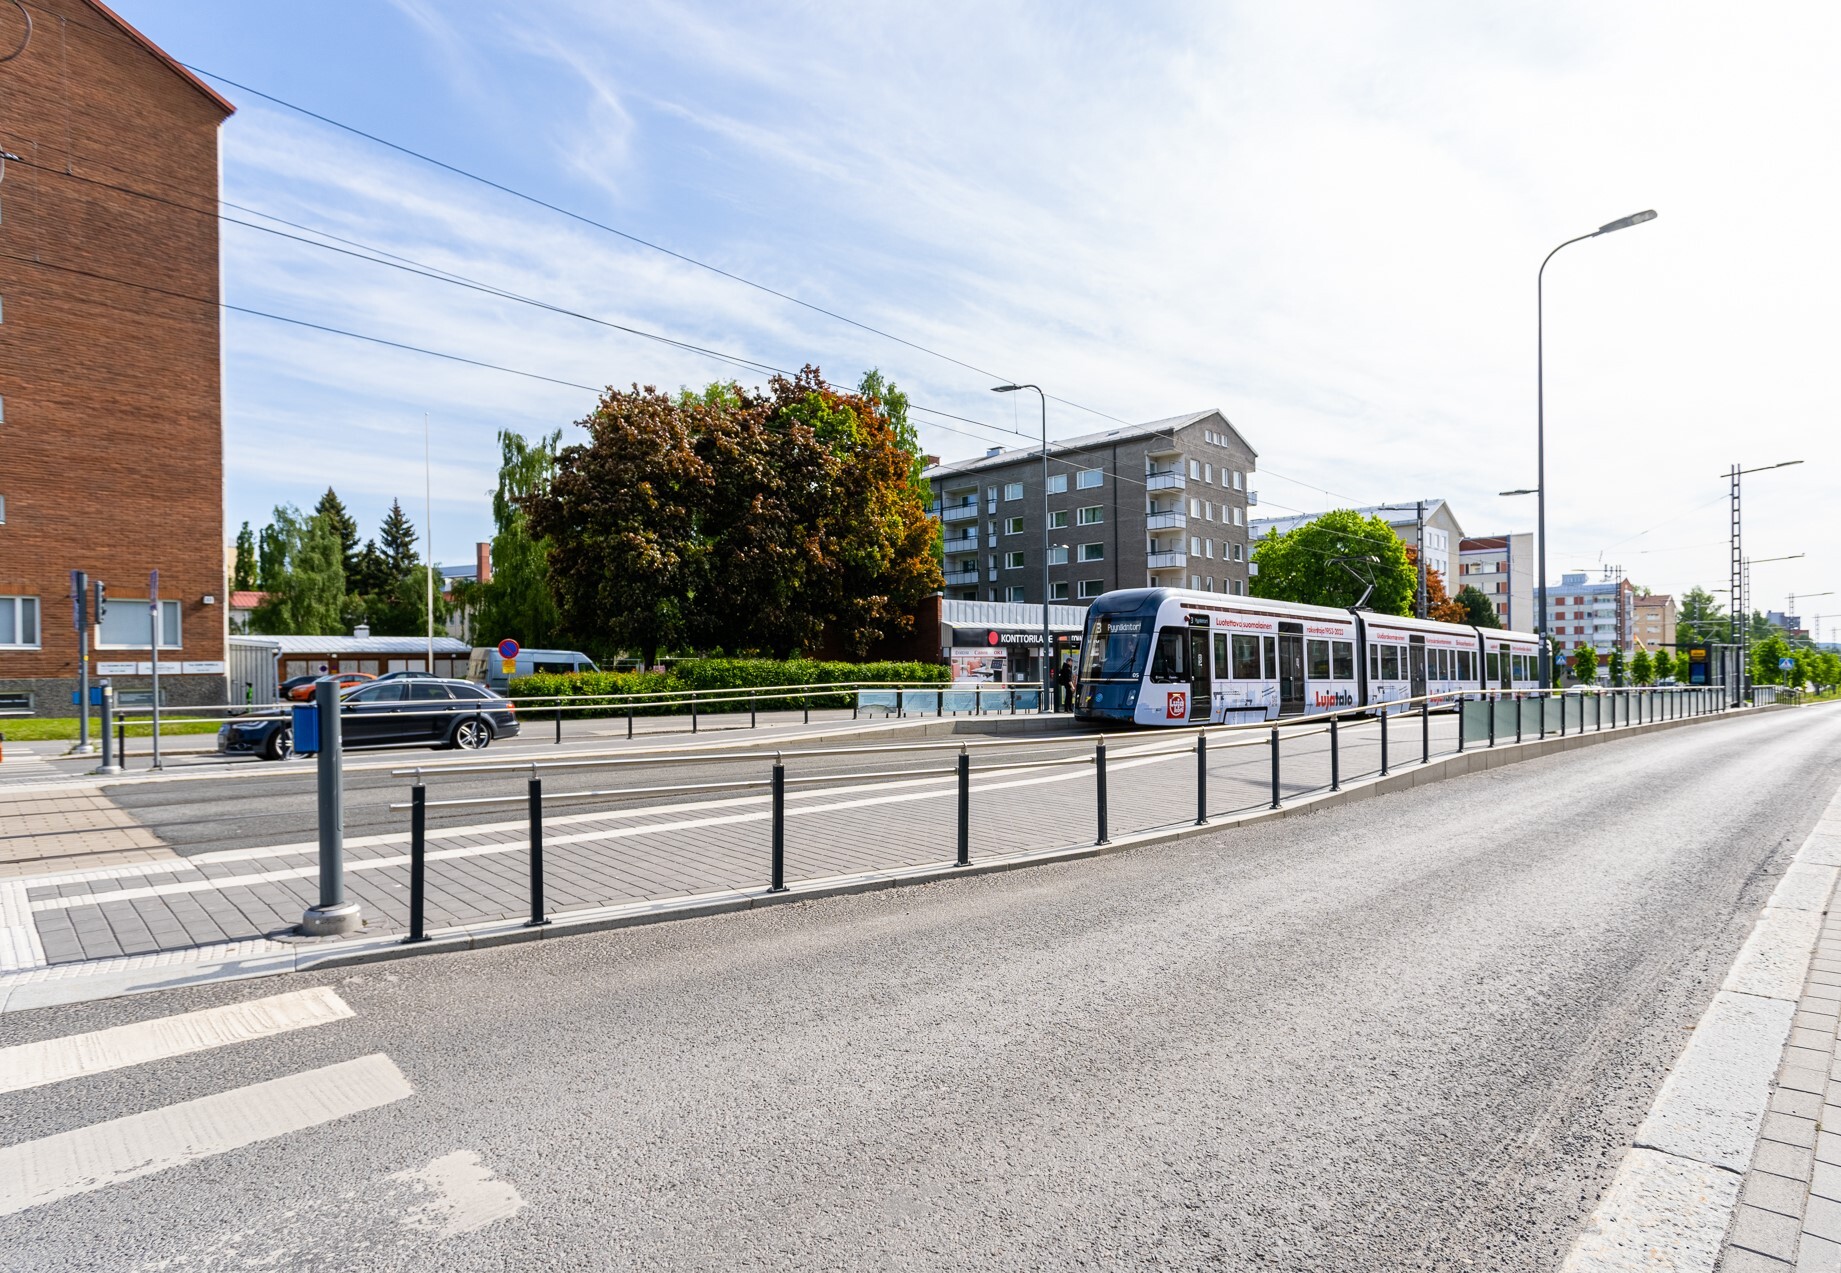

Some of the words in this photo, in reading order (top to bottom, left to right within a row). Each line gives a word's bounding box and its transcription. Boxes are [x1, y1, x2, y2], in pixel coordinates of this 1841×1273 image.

[1216, 617, 1242, 628] Luotettava
[1243, 620, 1273, 630] suomalainen
[1315, 689, 1353, 711] Lujatalo
